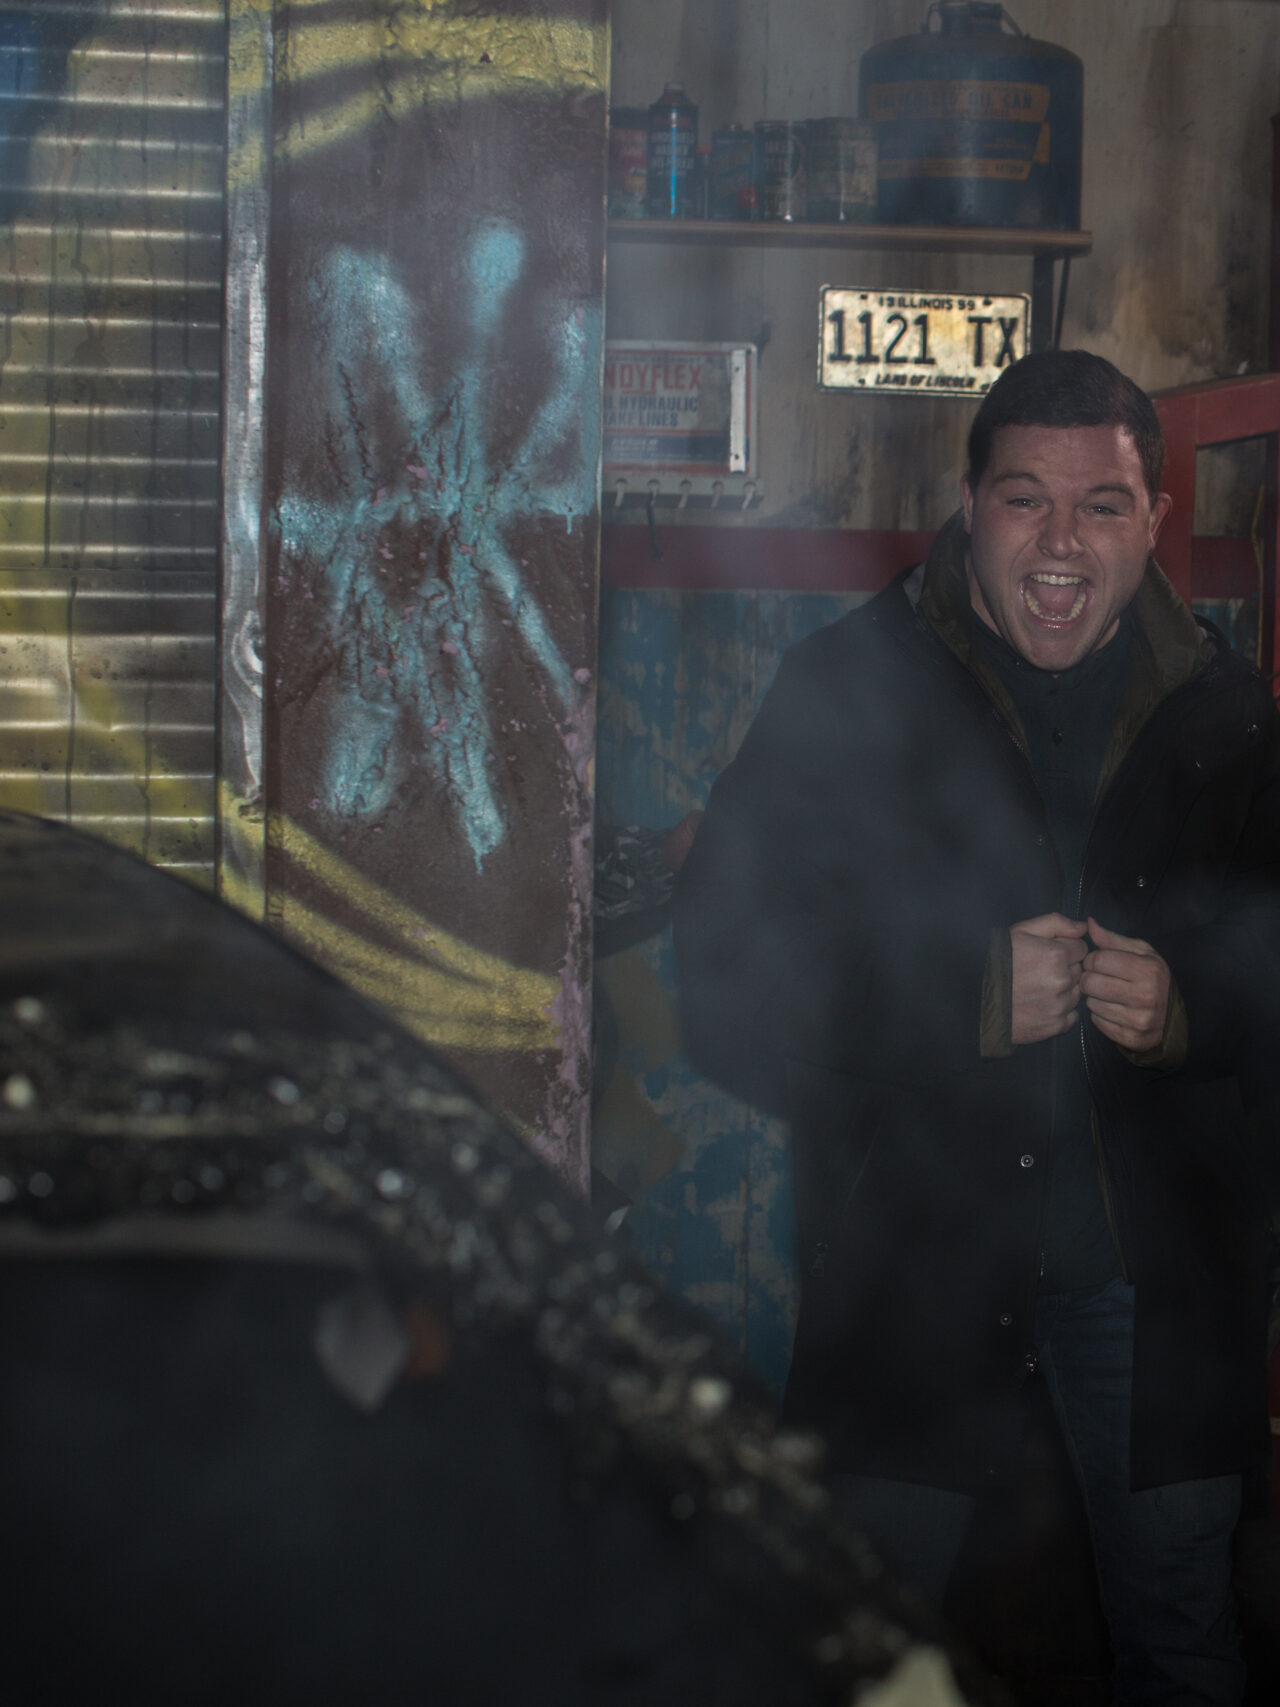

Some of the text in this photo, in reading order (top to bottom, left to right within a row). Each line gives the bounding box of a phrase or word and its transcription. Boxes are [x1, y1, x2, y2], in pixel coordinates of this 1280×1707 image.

[1003, 92, 1033, 109] CAN
[897, 297, 954, 310] ILLINOIS
[827, 310, 1020, 368] 1121 TX
[874, 373, 977, 388] LAND OF LINCOLN
[618, 396, 699, 412] HYDRAULIC
[638, 412, 679, 427] LINES
